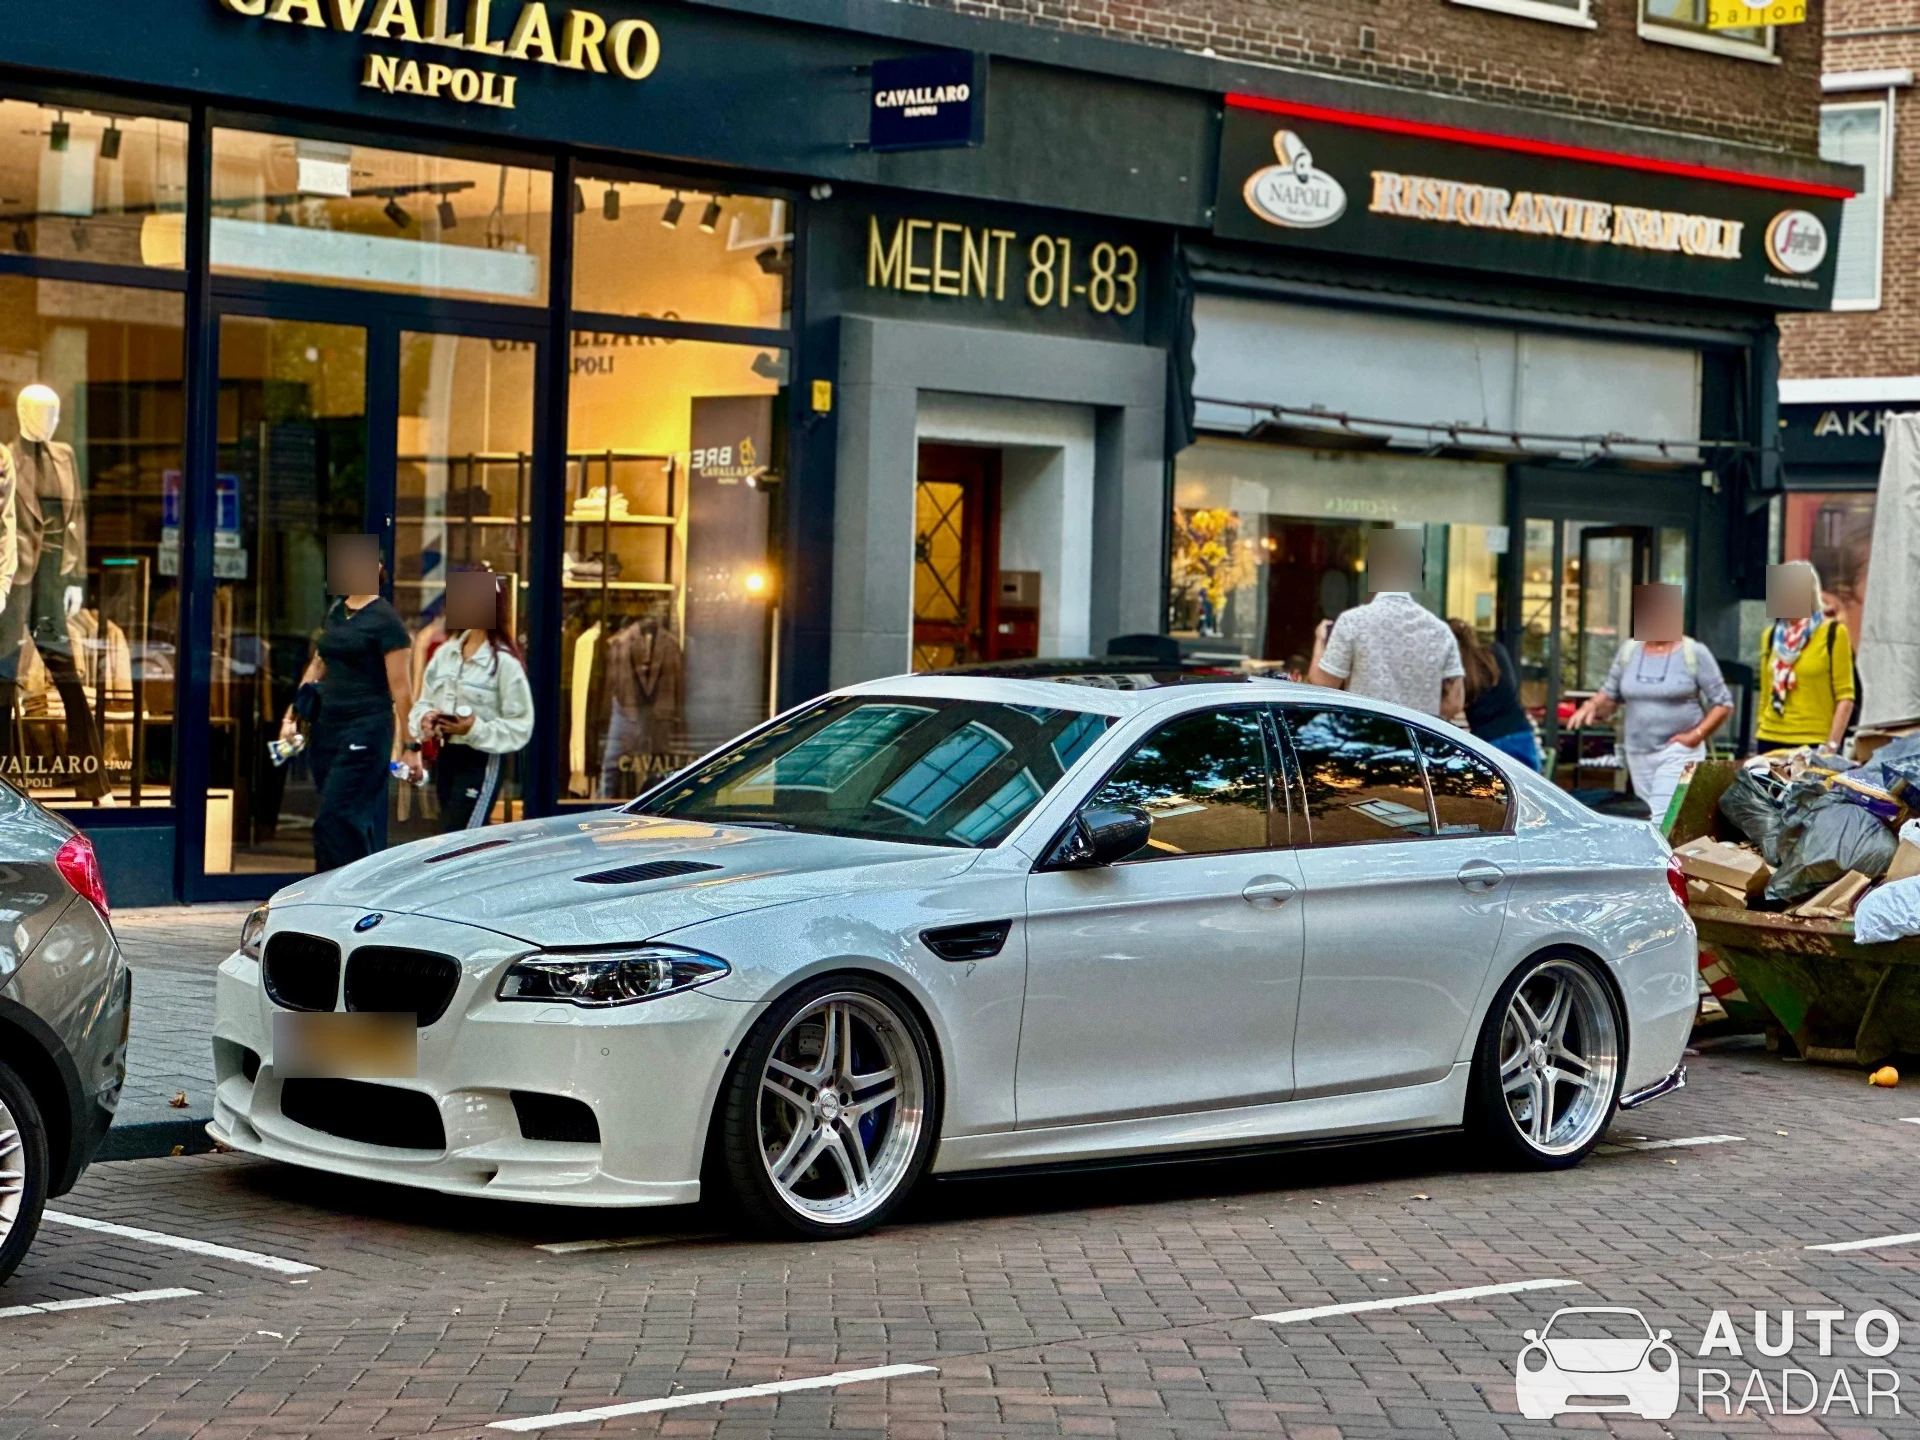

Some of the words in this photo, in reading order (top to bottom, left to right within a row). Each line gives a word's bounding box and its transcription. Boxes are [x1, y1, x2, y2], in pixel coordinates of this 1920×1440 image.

[221, 0, 660, 80] VALLARO
[361, 54, 516, 108] NAPOLI
[875, 84, 970, 107] CAVALLARO
[1269, 182, 1330, 209] NAPOLI
[1368, 171, 1612, 242] RISTORANTE
[1612, 205, 1744, 259] NAPOLI
[867, 215, 1016, 301] MEENT
[1027, 234, 1138, 315] 81-83
[12, 777, 53, 788] APOLI
